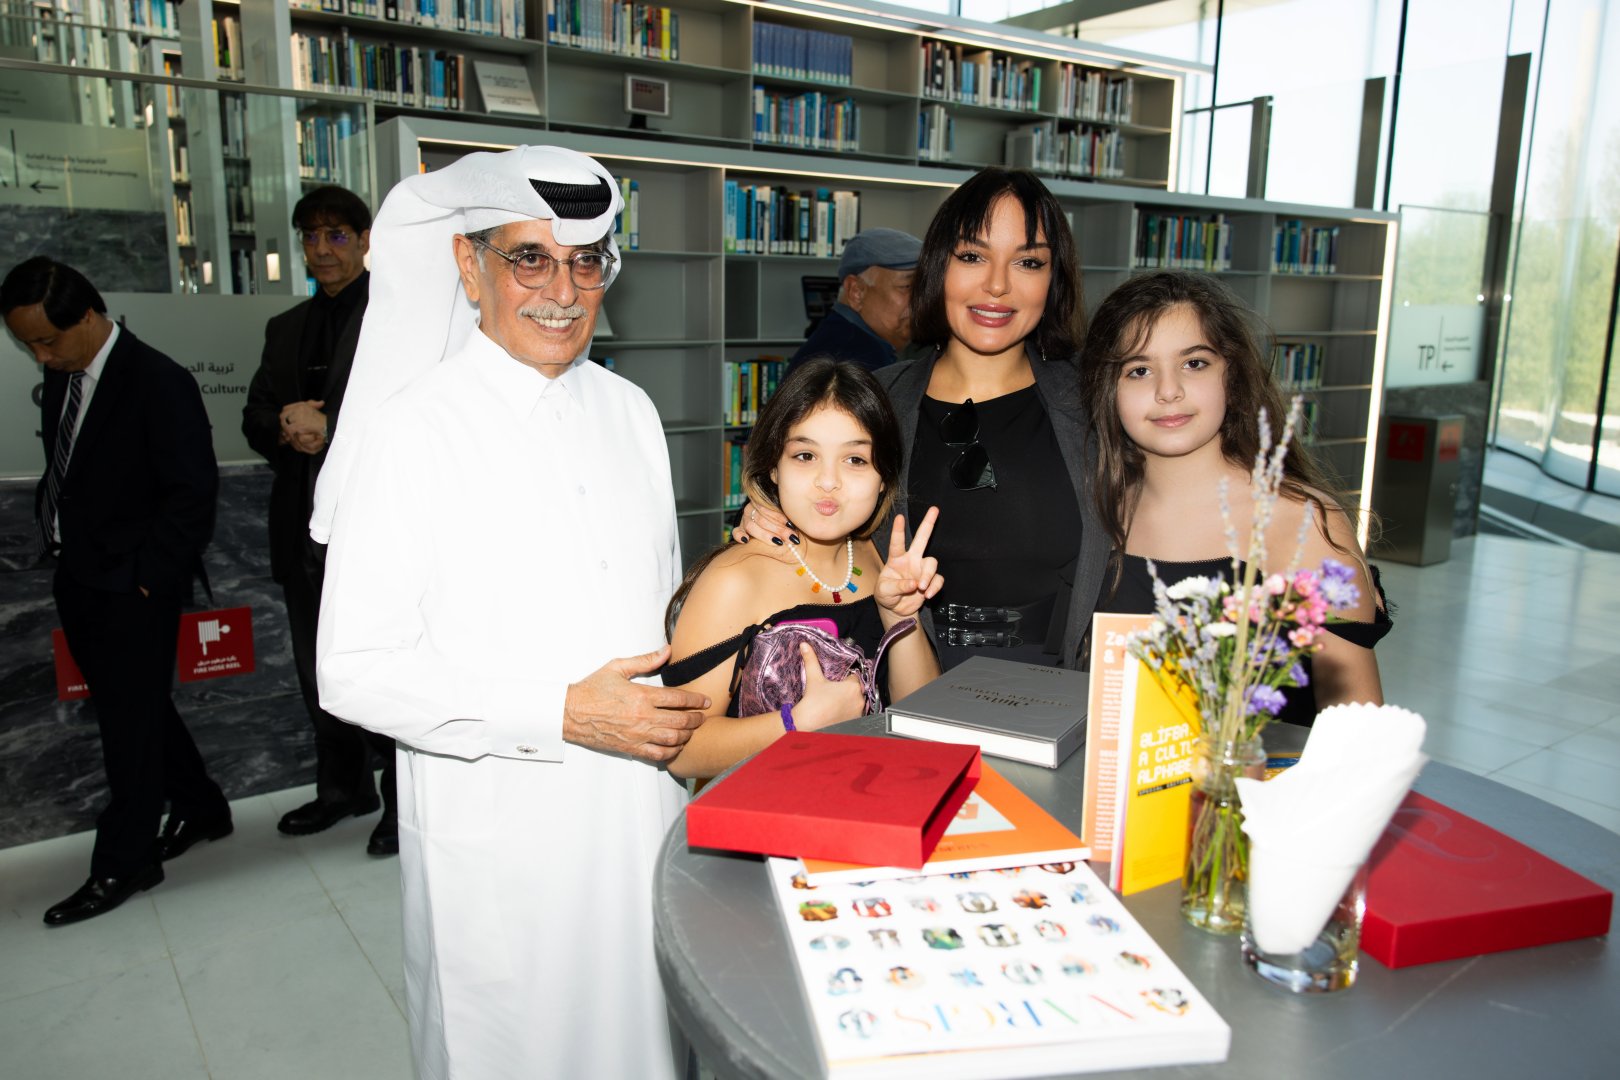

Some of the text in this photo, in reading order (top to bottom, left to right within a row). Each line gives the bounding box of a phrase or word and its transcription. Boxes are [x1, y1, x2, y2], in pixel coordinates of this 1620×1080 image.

[208, 362, 234, 375] تربية
[201, 383, 247, 394] Culture
[1138, 751, 1149, 767] A
[1137, 757, 1194, 785] ALPHABE
